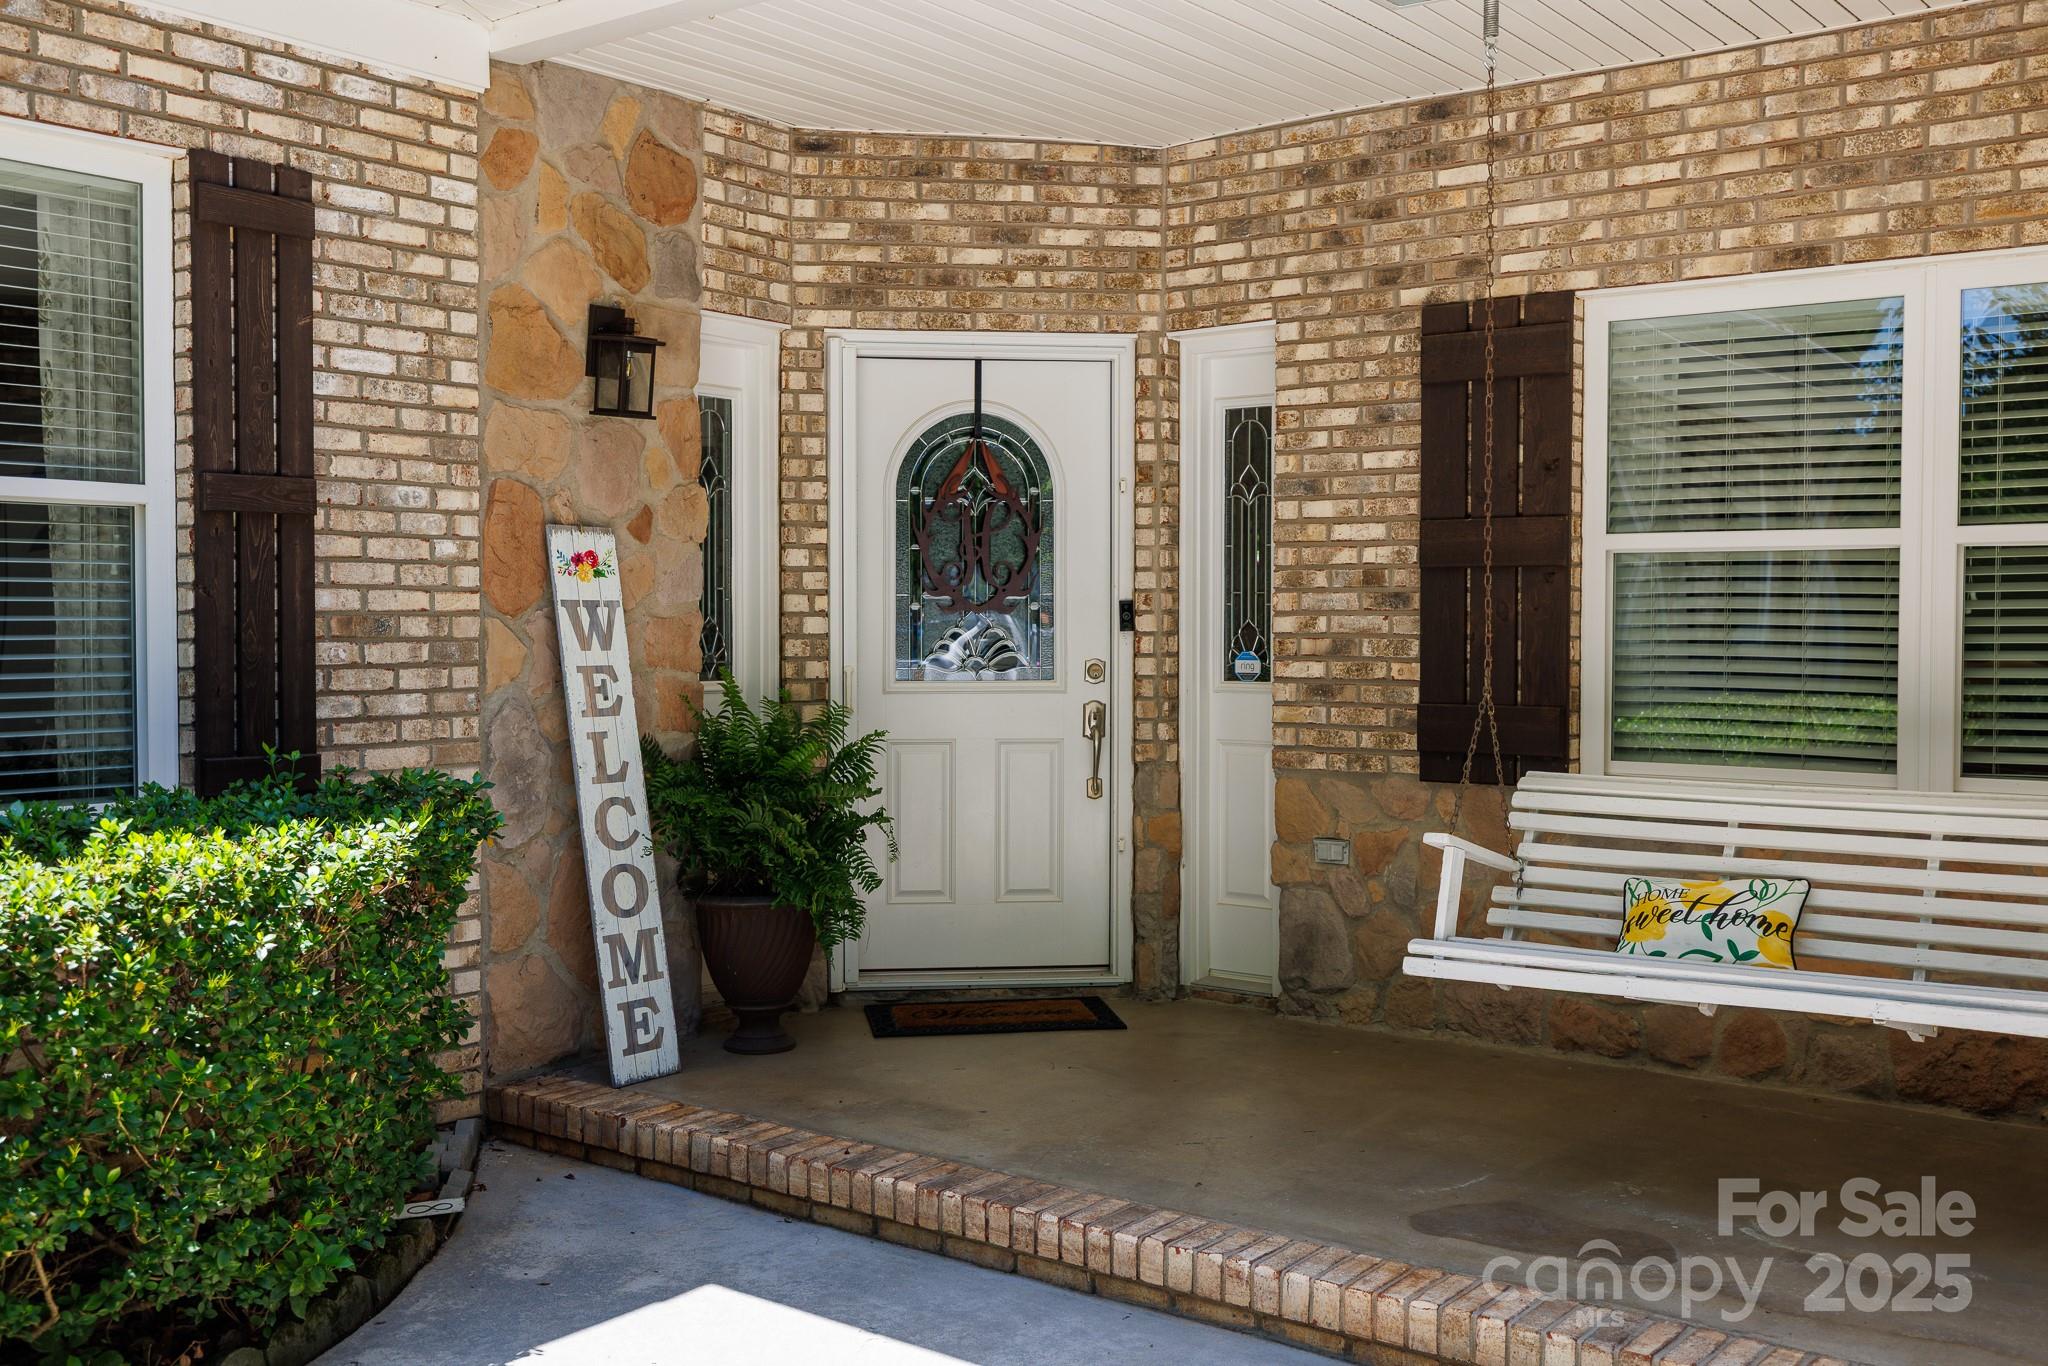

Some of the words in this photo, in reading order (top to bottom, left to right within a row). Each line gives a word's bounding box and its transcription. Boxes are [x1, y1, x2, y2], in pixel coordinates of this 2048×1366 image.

[559, 599, 665, 1058] WELCOME
[1622, 893, 1711, 937] sweet
[1708, 889, 1791, 942] home
[1636, 888, 1690, 907] HOME
